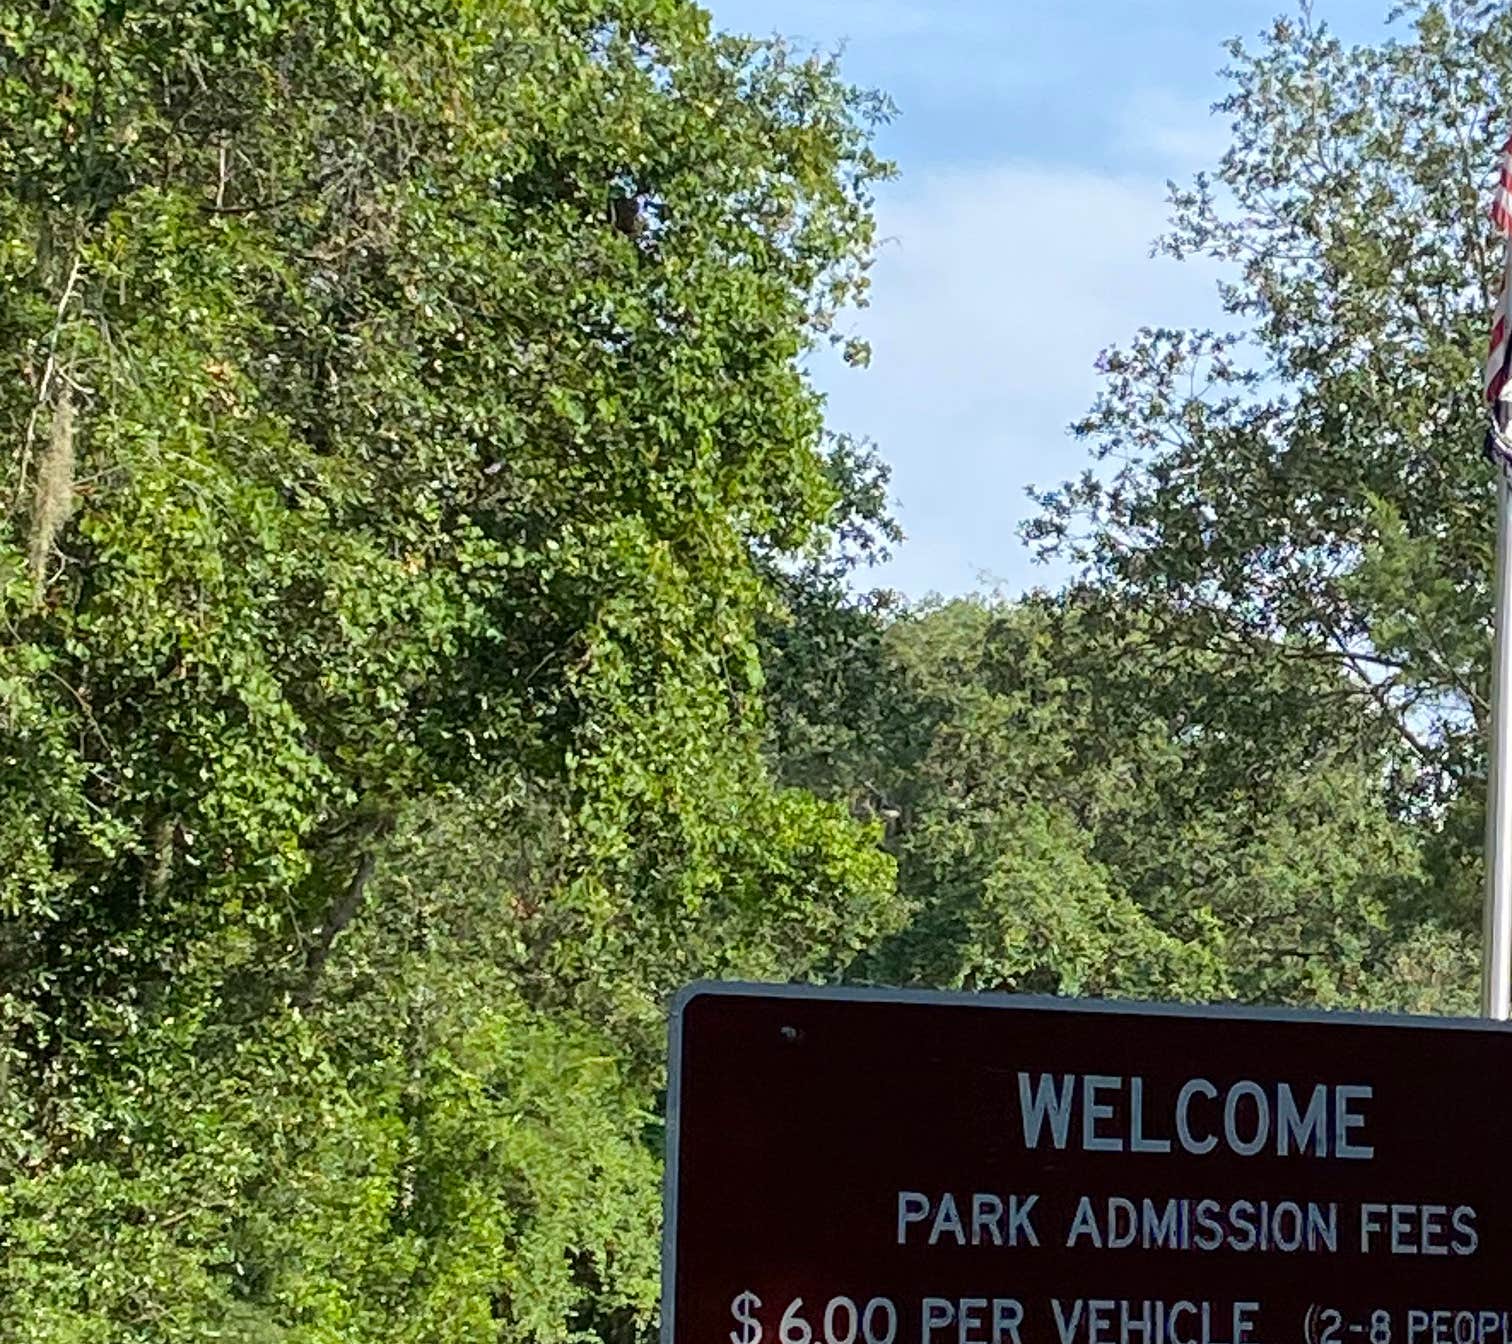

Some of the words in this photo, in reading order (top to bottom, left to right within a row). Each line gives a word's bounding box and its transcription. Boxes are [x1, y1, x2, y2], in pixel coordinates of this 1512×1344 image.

[1017, 1071, 1375, 1159] WELCOME
[897, 1191, 1041, 1247] PARK
[1065, 1195, 1337, 1252] ADMISSION
[1360, 1203, 1479, 1256] FEES
